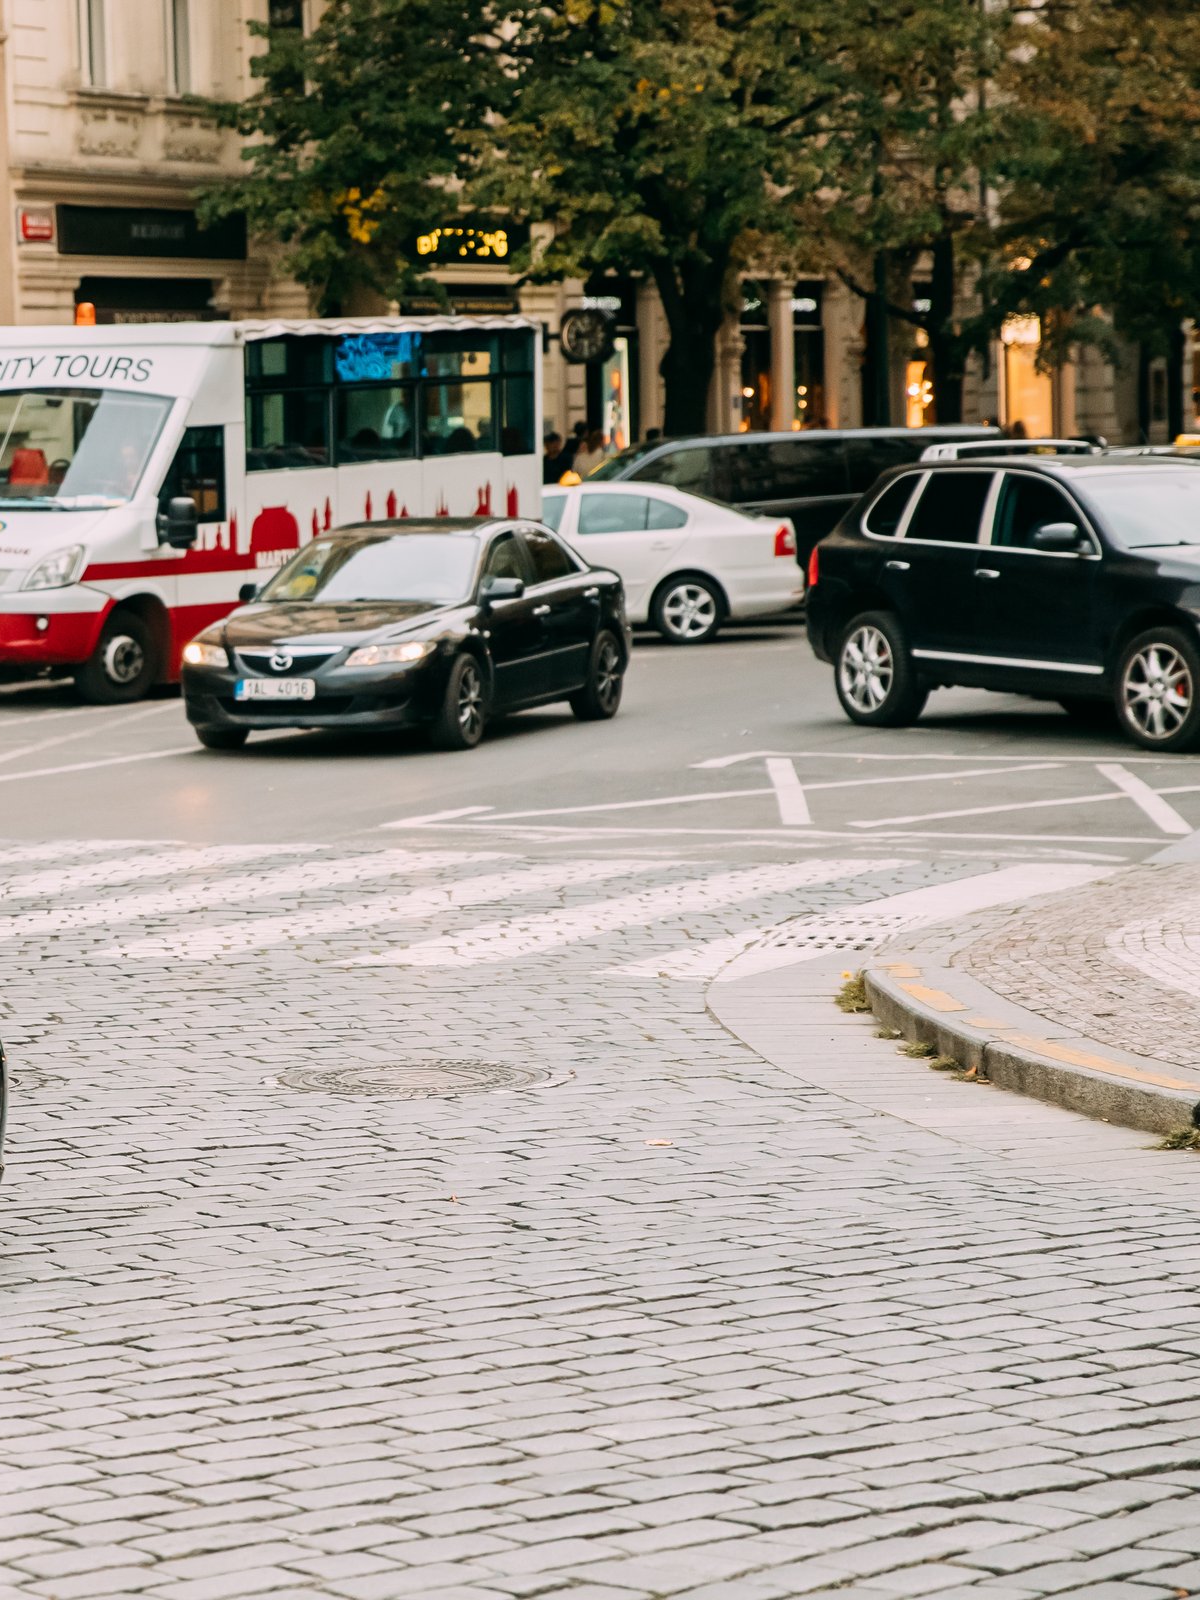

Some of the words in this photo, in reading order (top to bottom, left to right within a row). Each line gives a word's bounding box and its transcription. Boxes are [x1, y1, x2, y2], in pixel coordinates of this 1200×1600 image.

[53, 354, 153, 382] TOURS
[248, 683, 267, 695] 1AL
[278, 682, 308, 695] 4016
